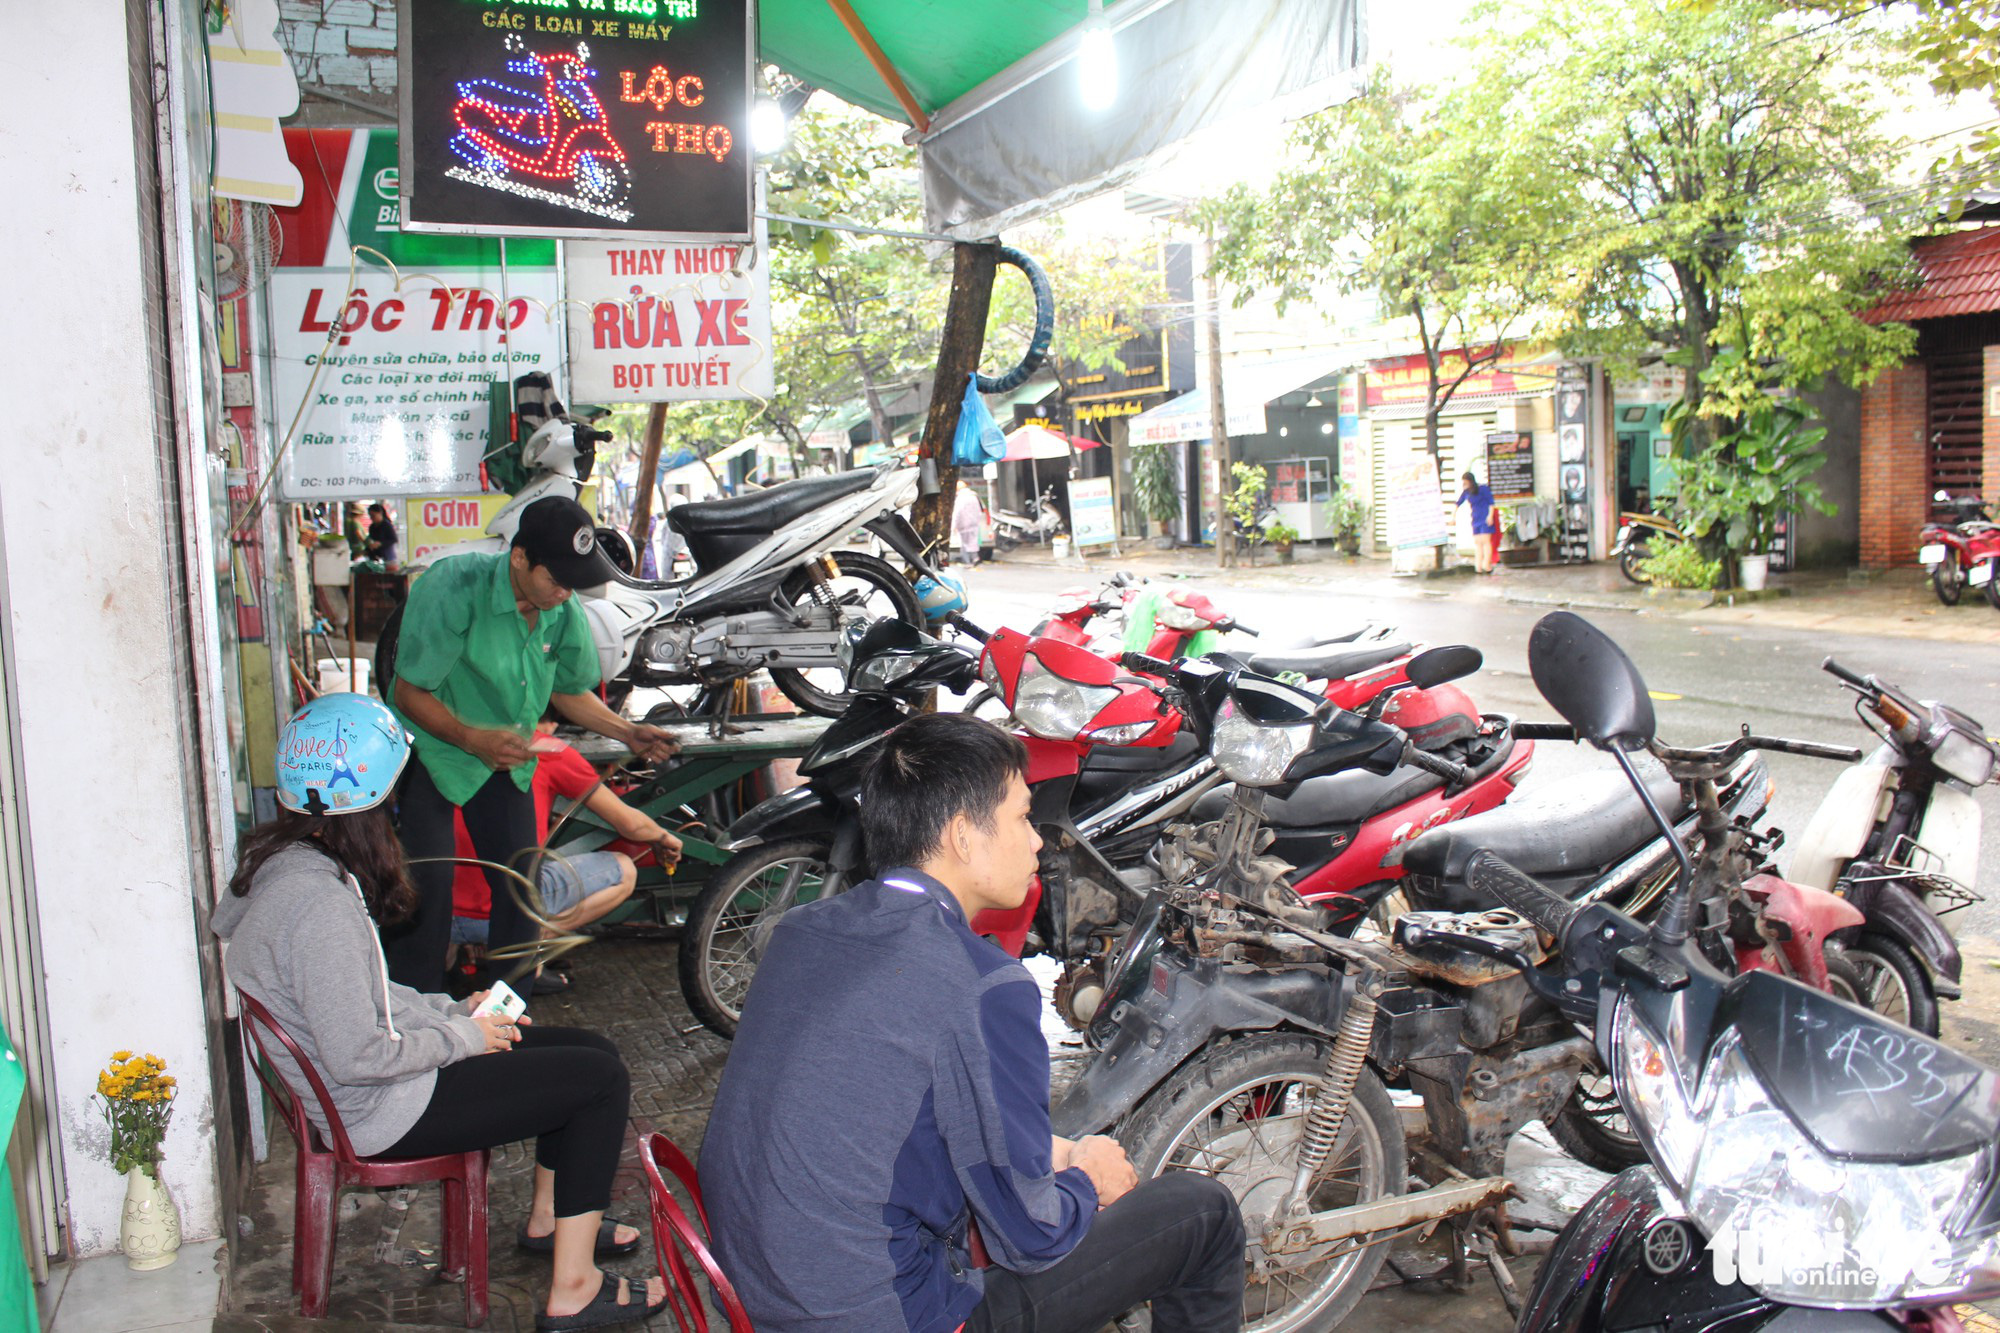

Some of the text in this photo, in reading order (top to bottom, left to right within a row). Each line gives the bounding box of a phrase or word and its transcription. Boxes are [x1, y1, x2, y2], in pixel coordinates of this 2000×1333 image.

[482, 7, 526, 30] CÁC
[592, 19, 621, 37] XE
[628, 19, 673, 41] MÁY
[620, 65, 704, 111] LỘC
[645, 121, 732, 163] THỌ
[607, 249, 666, 276] THAY
[299, 288, 405, 347] Lộc
[429, 288, 528, 345] Thọ
[592, 285, 751, 349] RỬA XE
[304, 353, 368, 367] Chuyên
[373, 352, 402, 364] sửa
[408, 352, 452, 365] chữa,
[457, 352, 487, 363] bảo
[341, 371, 498, 387] Các loại xe đời mới
[613, 354, 731, 393] BỌT TUYẾT
[317, 393, 339, 405] Xe
[345, 394, 369, 407] ga,
[375, 394, 394, 404] xe
[399, 389, 420, 403] số
[423, 391, 467, 403] chính
[450, 411, 470, 422] cũ
[302, 431, 334, 445] Rửa
[301, 478, 322, 487] ĐC:
[326, 477, 345, 486] 103
[348, 475, 381, 486] Phạm
[455, 473, 475, 482] ĐT:
[423, 500, 479, 527] CƠM
[300, 762, 333, 771] PARIS
